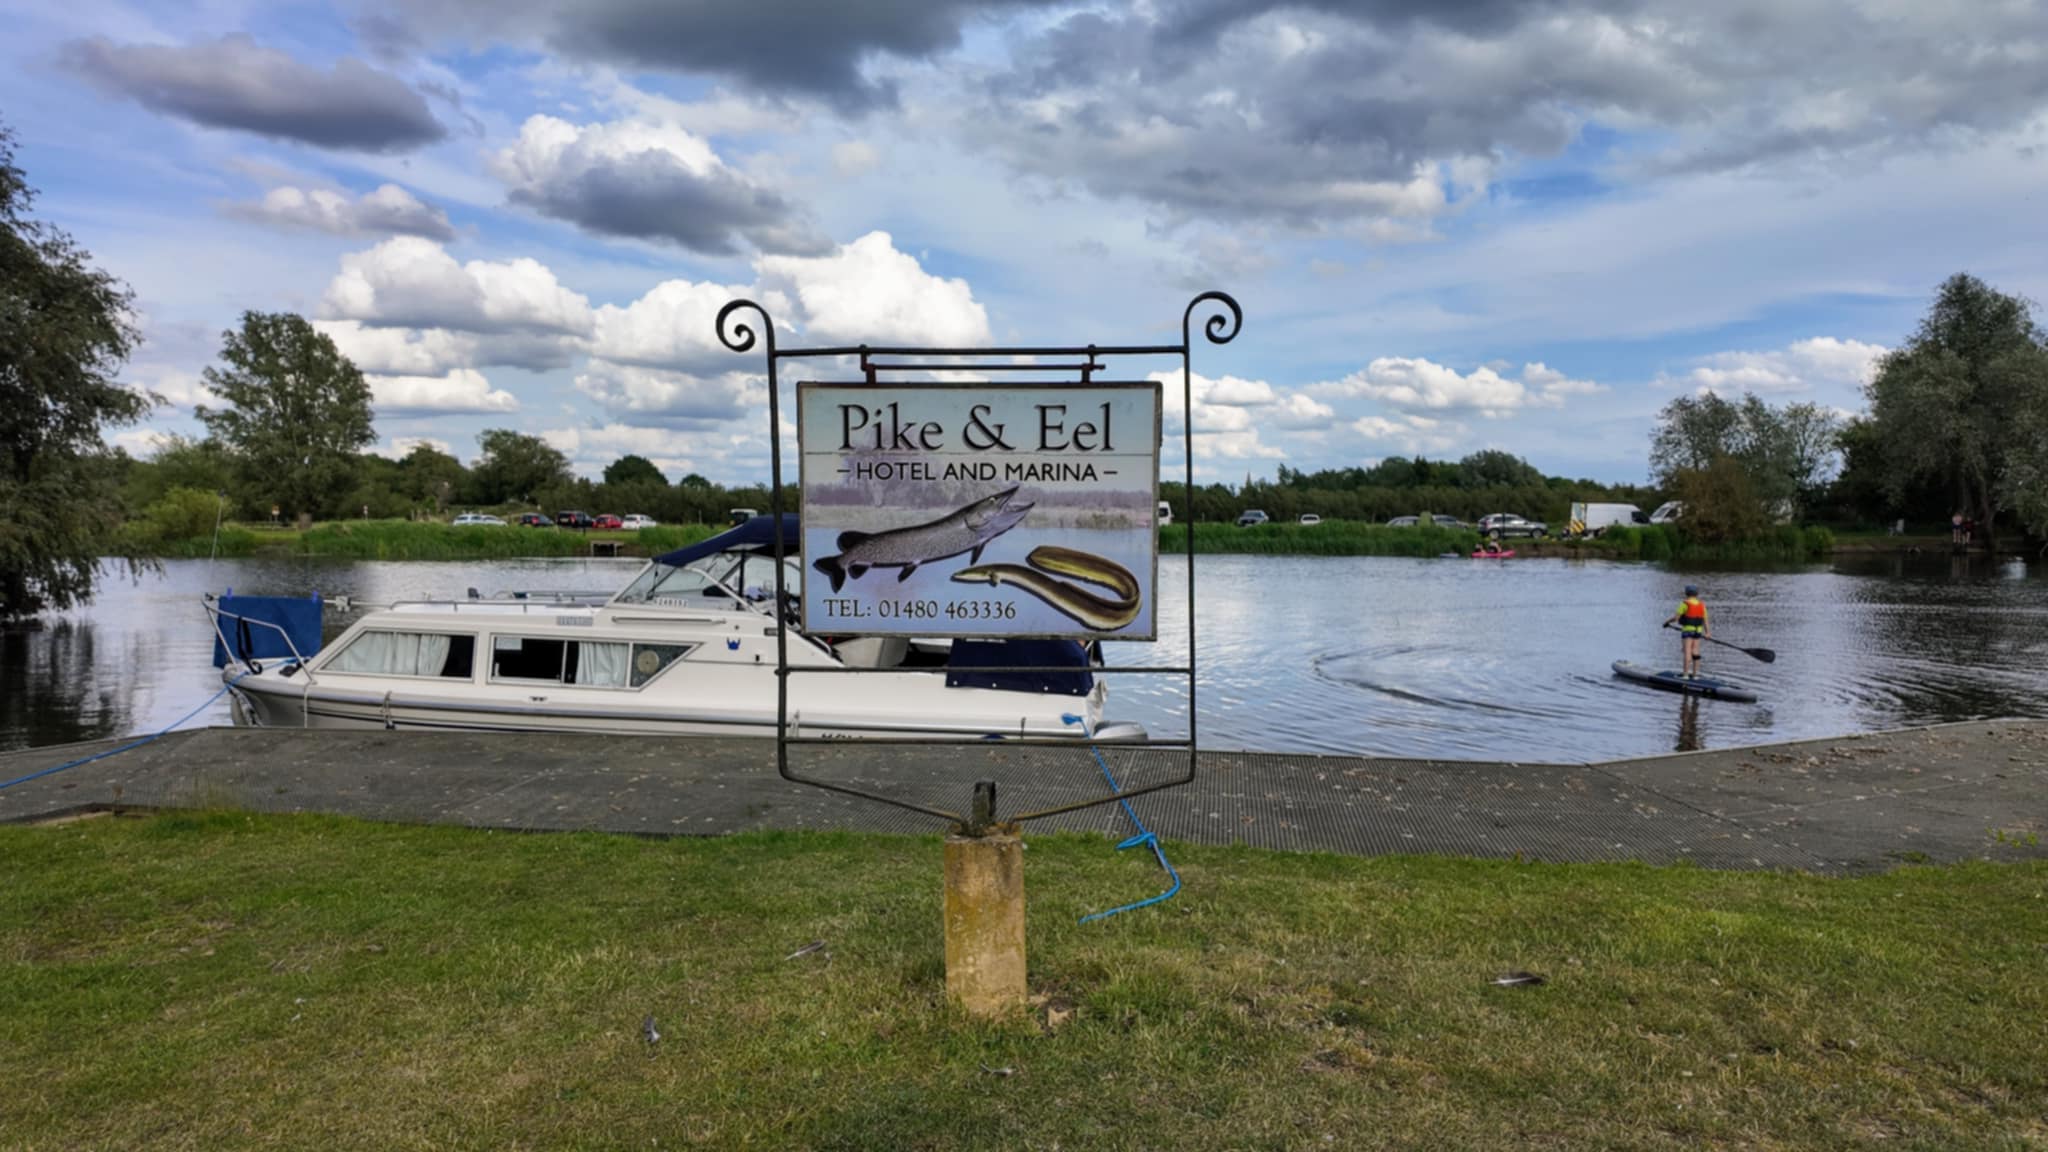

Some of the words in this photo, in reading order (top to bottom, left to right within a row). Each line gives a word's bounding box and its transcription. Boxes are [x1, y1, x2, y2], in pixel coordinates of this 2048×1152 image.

[838, 402, 943, 451] Pike
[963, 404, 1015, 450] &
[1035, 402, 1114, 451] Eel
[857, 462, 936, 481] HOTEL
[943, 462, 996, 481] AND
[1005, 462, 1097, 482] MARINA
[823, 599, 871, 618] TEL:
[878, 599, 937, 619] 01480
[945, 600, 1016, 619] 463336
